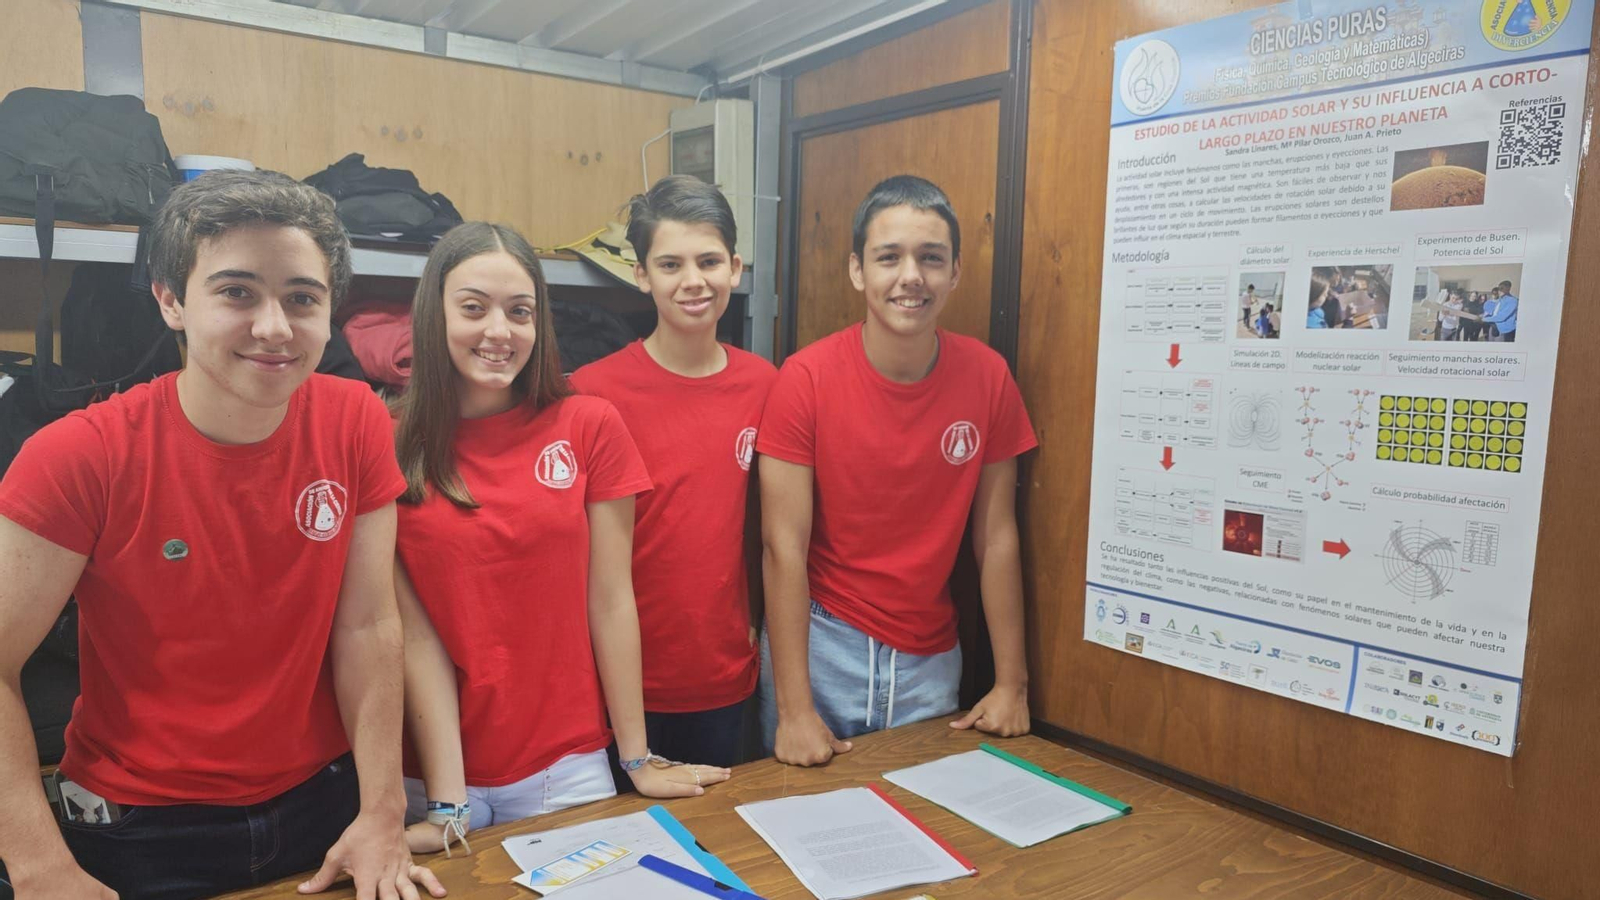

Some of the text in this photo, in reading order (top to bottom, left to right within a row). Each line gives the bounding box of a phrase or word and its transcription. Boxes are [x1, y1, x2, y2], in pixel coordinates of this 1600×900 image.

[1250, 8, 1386, 54] CIENCIAS PURAS
[1294, 47, 1340, 66] Geología
[1342, 48, 1348, 62] y
[1353, 31, 1429, 55] Matemáticas)
[1276, 72, 1317, 88] Campus
[1320, 60, 1386, 80] Tecnológico
[1390, 56, 1404, 69] de
[1407, 48, 1464, 69] Algeciras
[1134, 68, 1557, 140] ESTUDIO DE LA ACTIVIDAD SOLAR Y SU INFLUENCIA A CORTO-
[1508, 94, 1562, 108] Referencias
[1199, 107, 1447, 150] LARGO PLAZO EN NUESTRO PLANETA
[1225, 146, 1249, 155] Sandra
[1251, 144, 1279, 152] Linares,
[1293, 139, 1310, 147] Pilar
[1313, 136, 1341, 144] Orozco,
[1376, 127, 1401, 137] Prieto
[1118, 152, 1176, 170] Introducción
[1334, 161, 1350, 170] baja
[1355, 160, 1370, 169] que
[1329, 174, 1361, 182] observar
[1365, 173, 1369, 181] y
[1285, 188, 1314, 197] rotación
[1318, 186, 1335, 194] solar
[1338, 184, 1364, 193] debido
[1264, 202, 1301, 212] erupciones
[1351, 195, 1384, 204] destellos
[1320, 209, 1360, 220] eyecciones
[1362, 210, 1366, 218] y
[1368, 209, 1383, 217] que
[1417, 232, 1520, 246] Experimento de Busen.
[1112, 250, 1170, 264] Metodología
[1308, 249, 1350, 258] Experiencia
[1365, 246, 1399, 255] Herschel
[1433, 246, 1503, 257] Potencia del Sol
[1233, 350, 1268, 358] Simulación
[1295, 351, 1379, 360] Modelización reacción
[1388, 353, 1520, 365] Seguimiento manchas solares.
[1312, 362, 1361, 372] nuclear solar
[1397, 365, 1510, 377] Velocidad rotacional solar
[1240, 468, 1281, 480] Seguimiento
[1372, 486, 1505, 510] Cálculo probabilidad afectación
[1100, 541, 1164, 562] Conclusiones
[1241, 579, 1253, 589] del
[1255, 582, 1268, 593] Sol,
[1272, 587, 1292, 596] como
[1306, 595, 1328, 605] papel
[1355, 605, 1416, 622] mantenimiento
[1420, 617, 1431, 625] de
[1435, 619, 1443, 628] la
[1447, 622, 1466, 632] vida
[1471, 628, 1477, 636] y
[1498, 631, 1507, 640] la
[1234, 589, 1277, 604] relacionadas
[1298, 602, 1340, 618] fenómenos
[1344, 614, 1371, 625] solares
[1376, 621, 1392, 629] que
[1396, 626, 1428, 637] pueden
[1432, 632, 1464, 645] afectar
[1470, 641, 1505, 653] nuestra
[1307, 656, 1341, 669] EVOS
